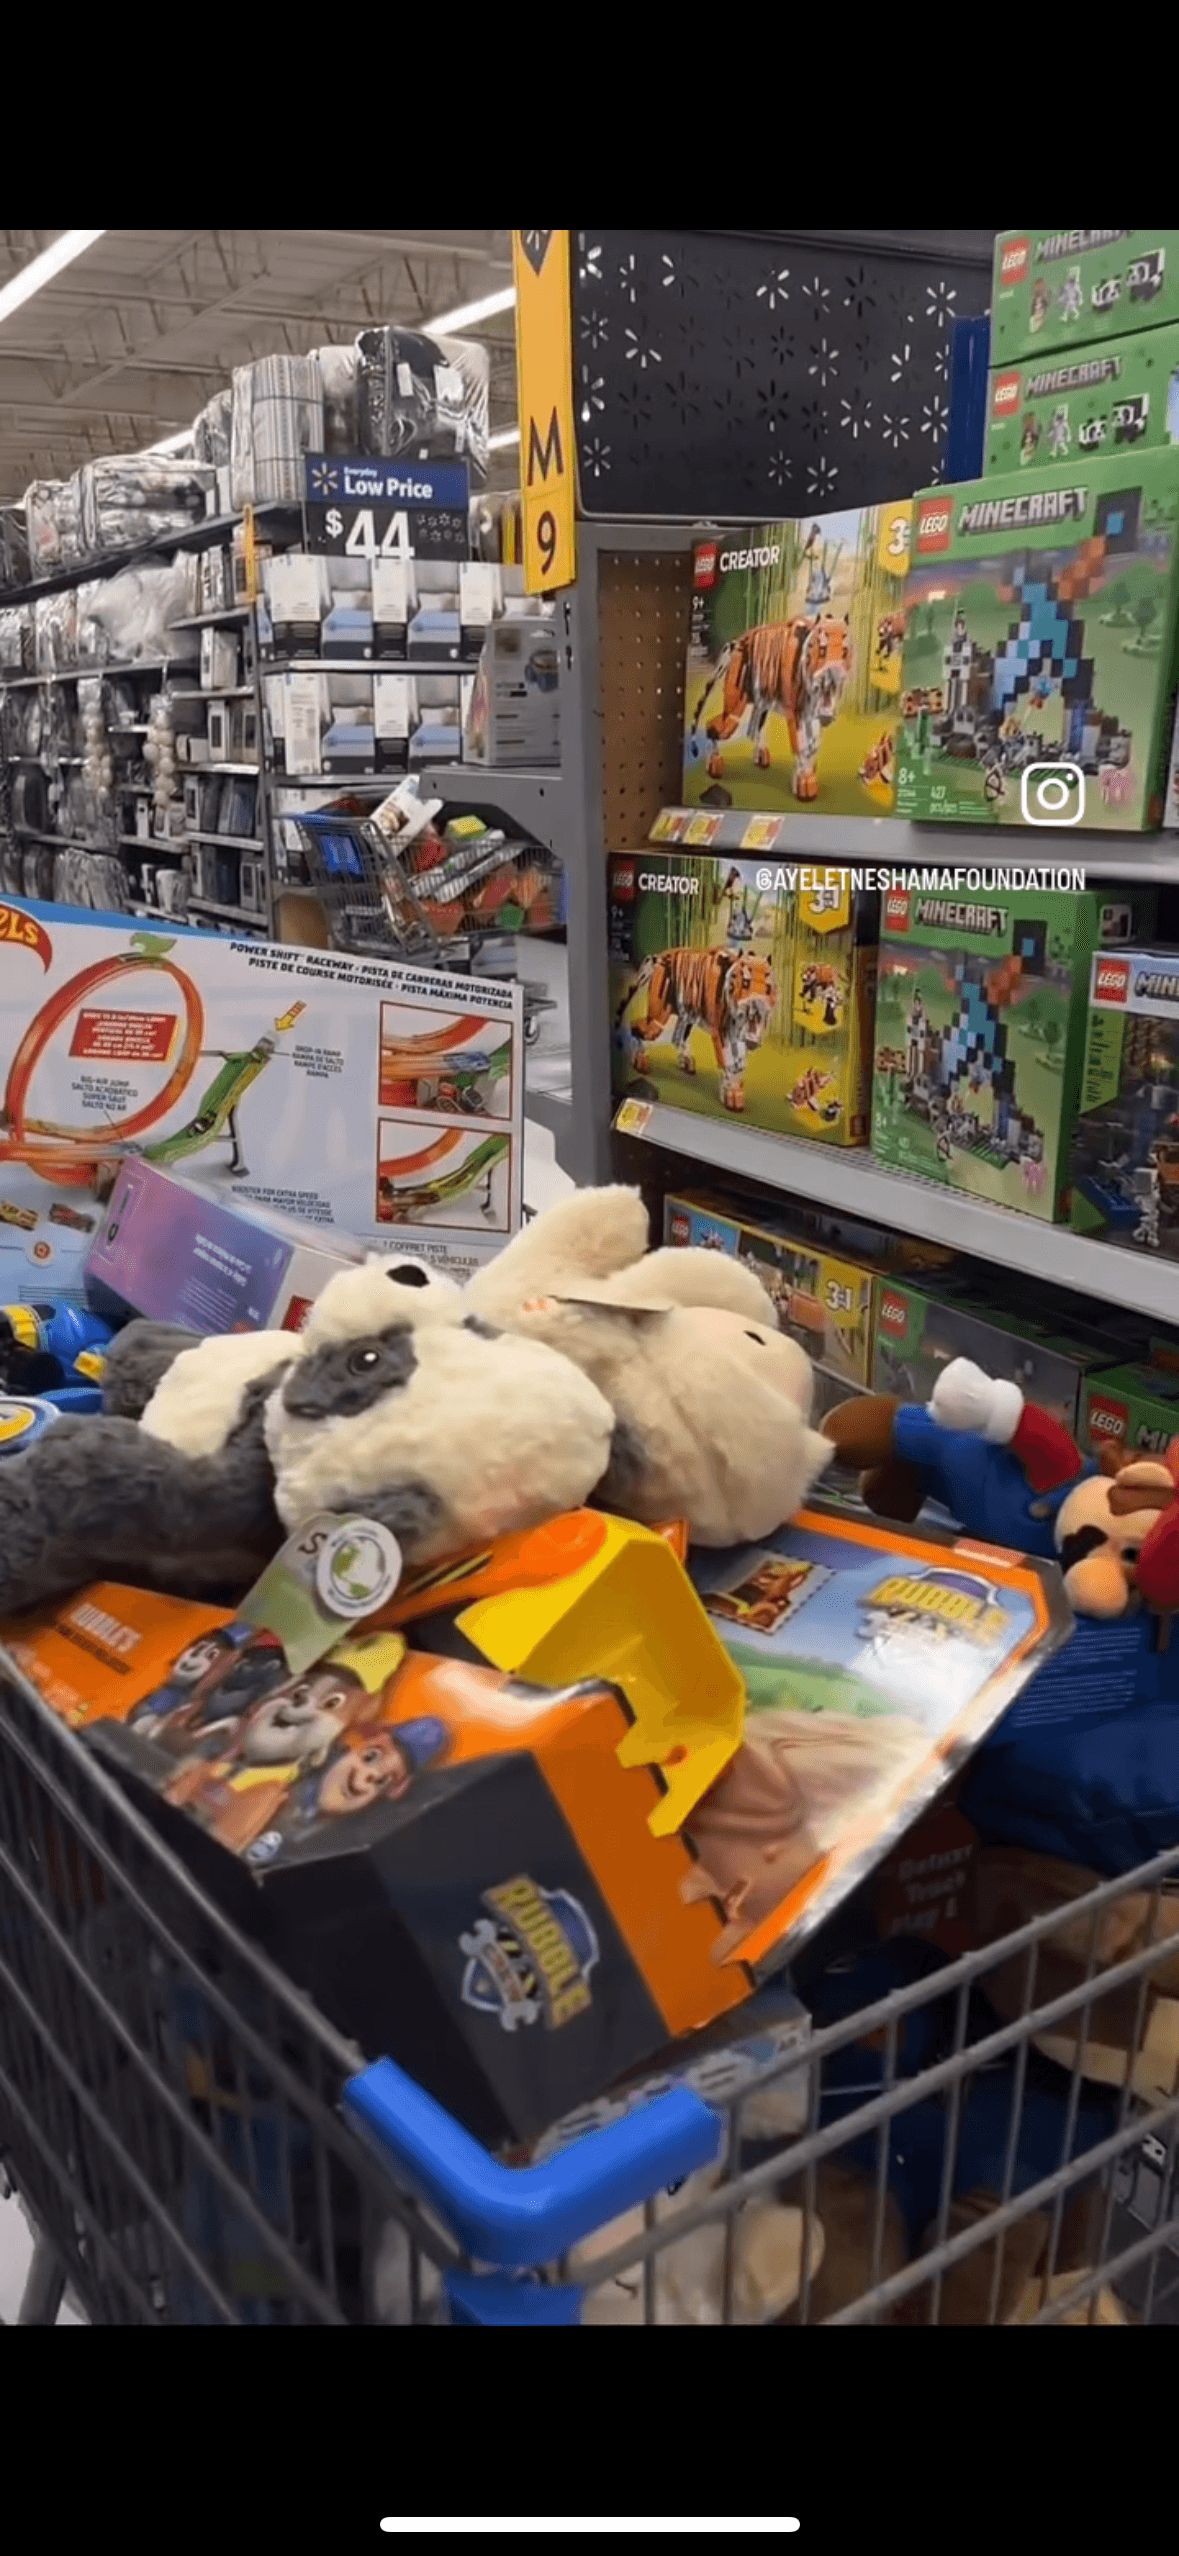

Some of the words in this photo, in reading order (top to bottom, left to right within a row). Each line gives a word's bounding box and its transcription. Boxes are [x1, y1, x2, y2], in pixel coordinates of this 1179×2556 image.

[1026, 356, 1122, 400] MINECRAFT
[527, 405, 564, 486] M
[343, 466, 378, 478] Everyday
[344, 475, 383, 496] Low
[386, 477, 433, 499] Price
[919, 514, 949, 535] LEGO
[957, 486, 1088, 535] MINECRAFT
[537, 510, 557, 575] 9
[719, 545, 780, 572] CREATOR
[898, 766, 916, 785] 8+
[638, 873, 700, 896] CREATOR
[886, 898, 909, 915] LEGO
[916, 897, 1008, 932] MINECRAFT
[230, 941, 268, 958] POWER
[270, 949, 299, 962] SHIFT
[306, 954, 354, 973] RACEWAY
[361, 965, 389, 978] PISTA
[391, 970, 403, 981] DE
[405, 972, 453, 989] CARRERAS
[455, 981, 513, 999] MOTORIZADA
[248, 957, 278, 971] PISTE
[281, 963, 294, 973] DE
[296, 965, 336, 980] COURSE
[401, 983, 428, 996] PISTA
[470, 993, 513, 1010] POTENCIA
[1098, 971, 1127, 988] LEGO
[1134, 970, 1179, 998] MIN
[882, 1303, 907, 1325] LEGO
[1090, 1410, 1123, 1435] LEGO
[480, 1872, 593, 2030] RUBBLE
